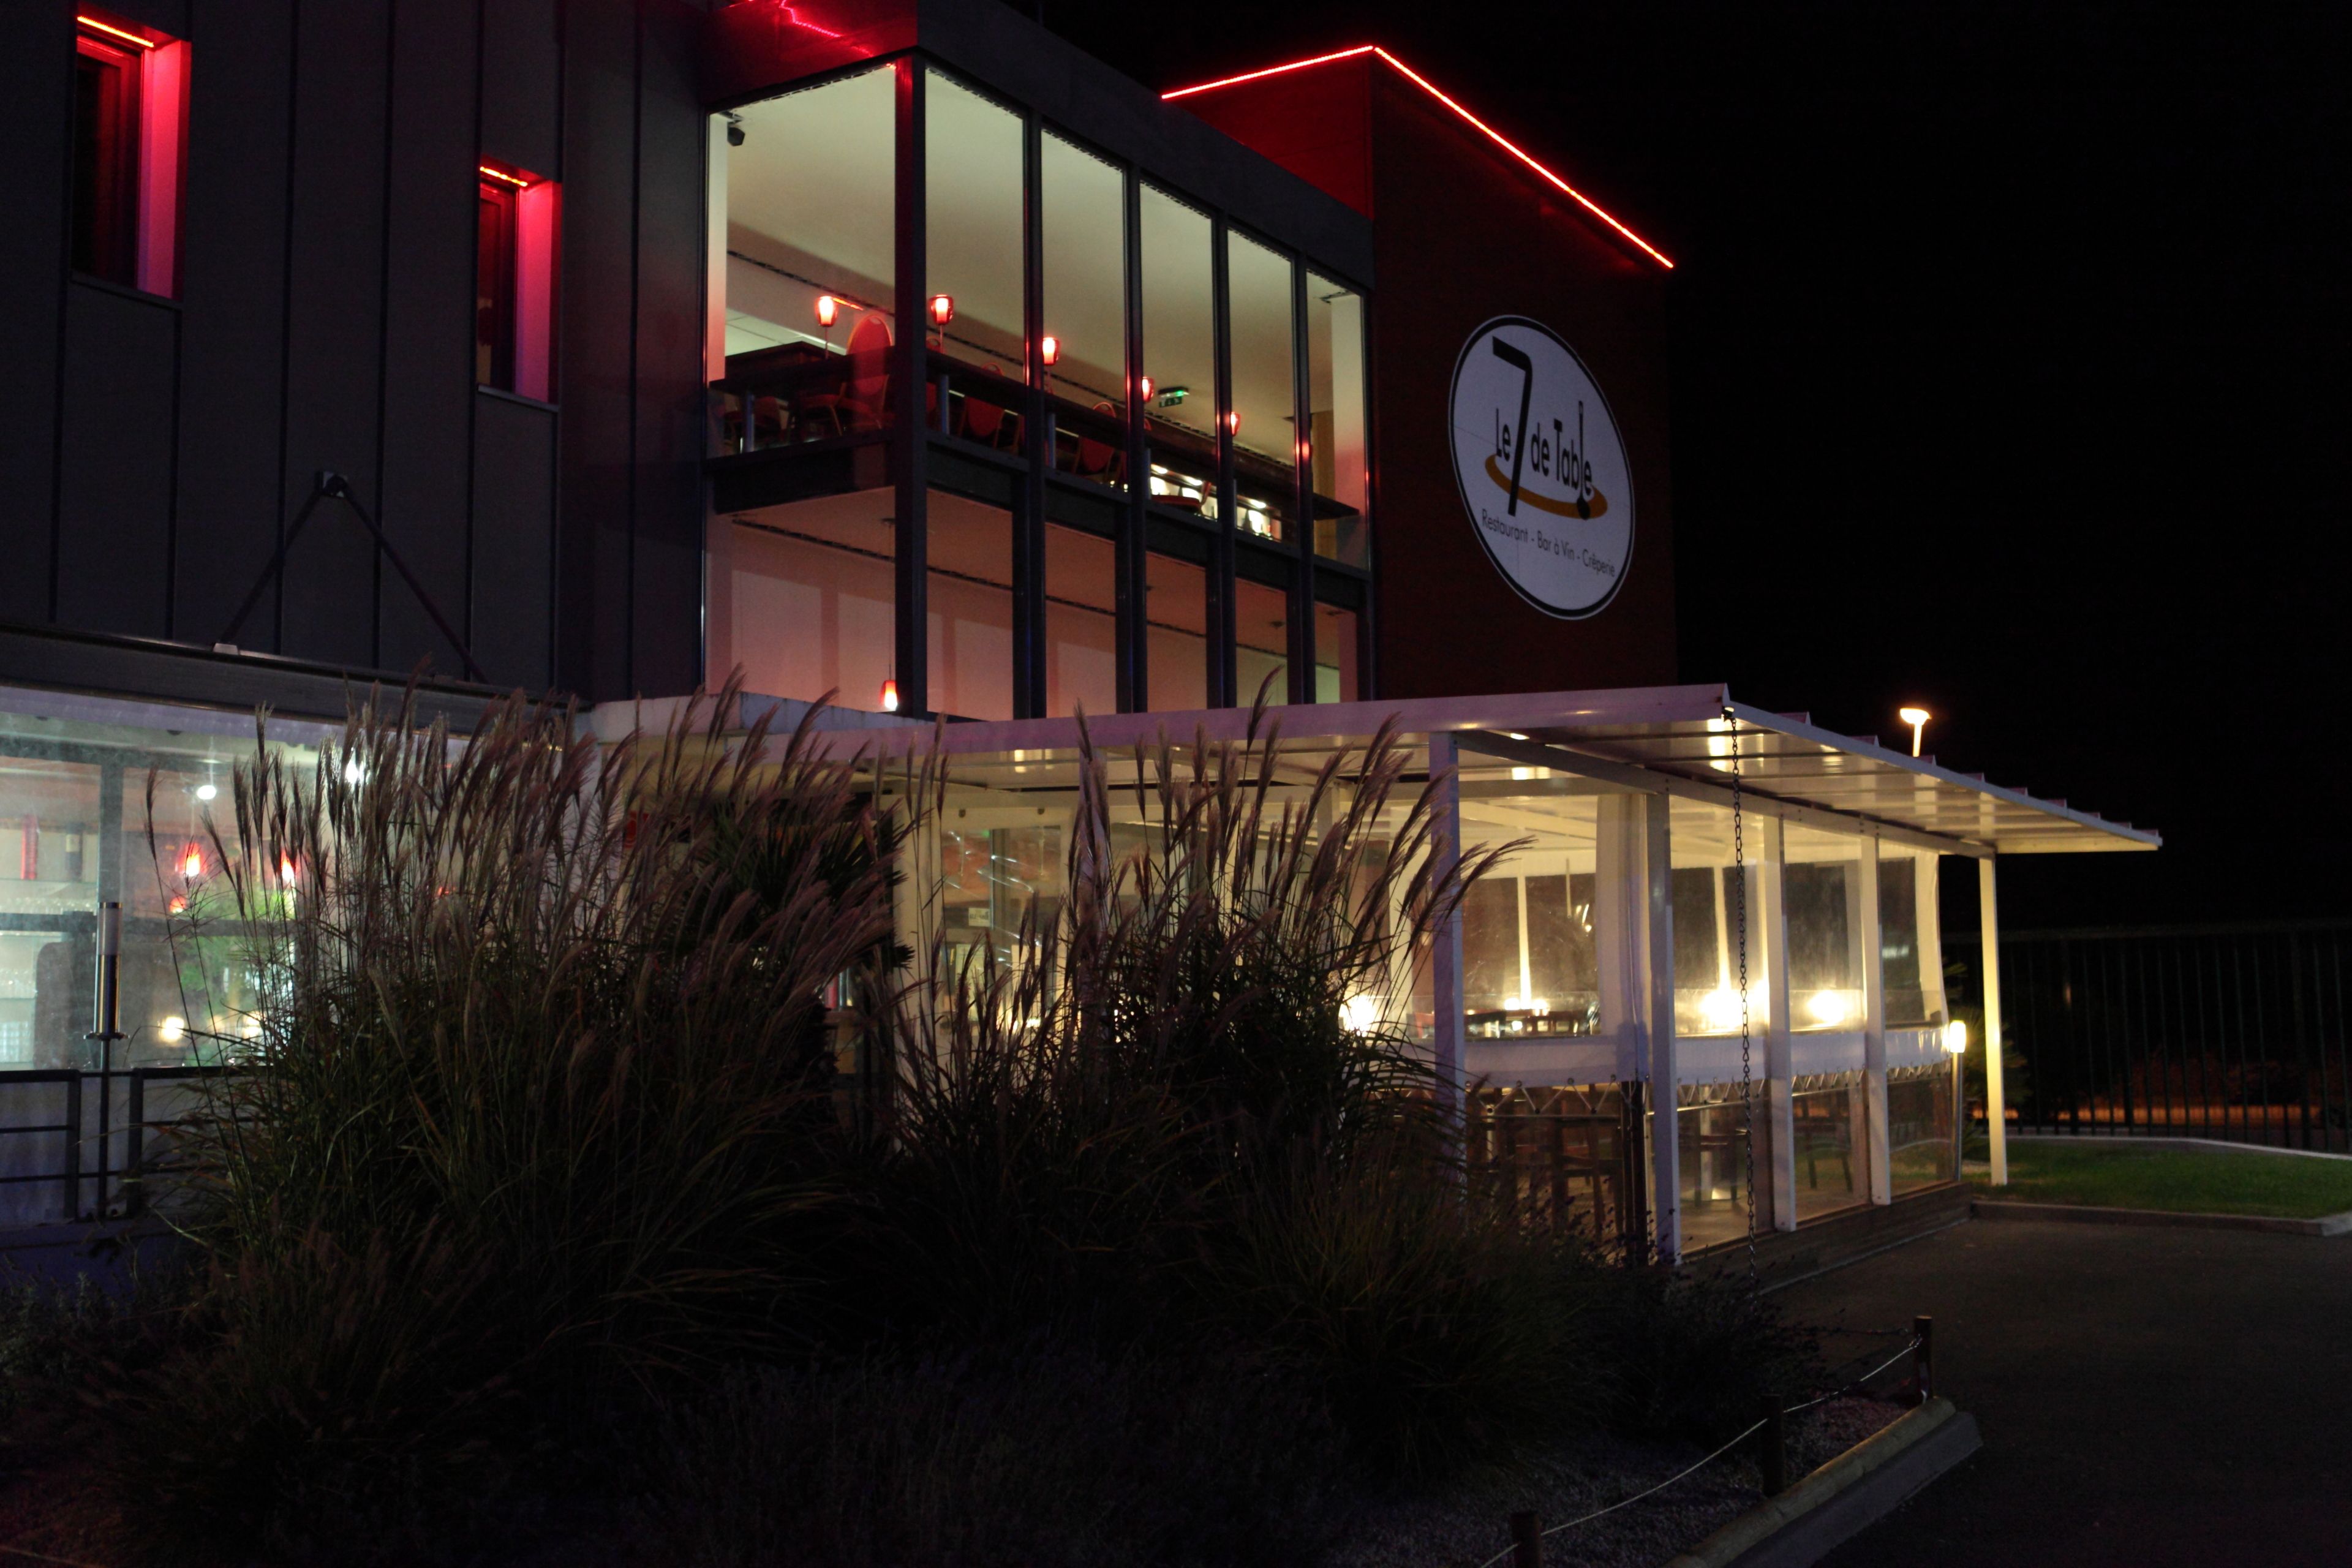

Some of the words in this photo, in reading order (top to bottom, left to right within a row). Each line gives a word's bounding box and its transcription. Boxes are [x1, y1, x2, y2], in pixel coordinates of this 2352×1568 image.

[1493, 336, 1532, 517] 7
[1496, 408, 1511, 462] Le
[1531, 422, 1550, 477] de
[1553, 401, 1592, 520] Table
[1482, 509, 1528, 543] Restaurant
[1537, 531, 1551, 551] Bar
[1555, 538, 1559, 555] à
[1561, 540, 1574, 560] Vin
[1583, 549, 1615, 577] Crêperie
